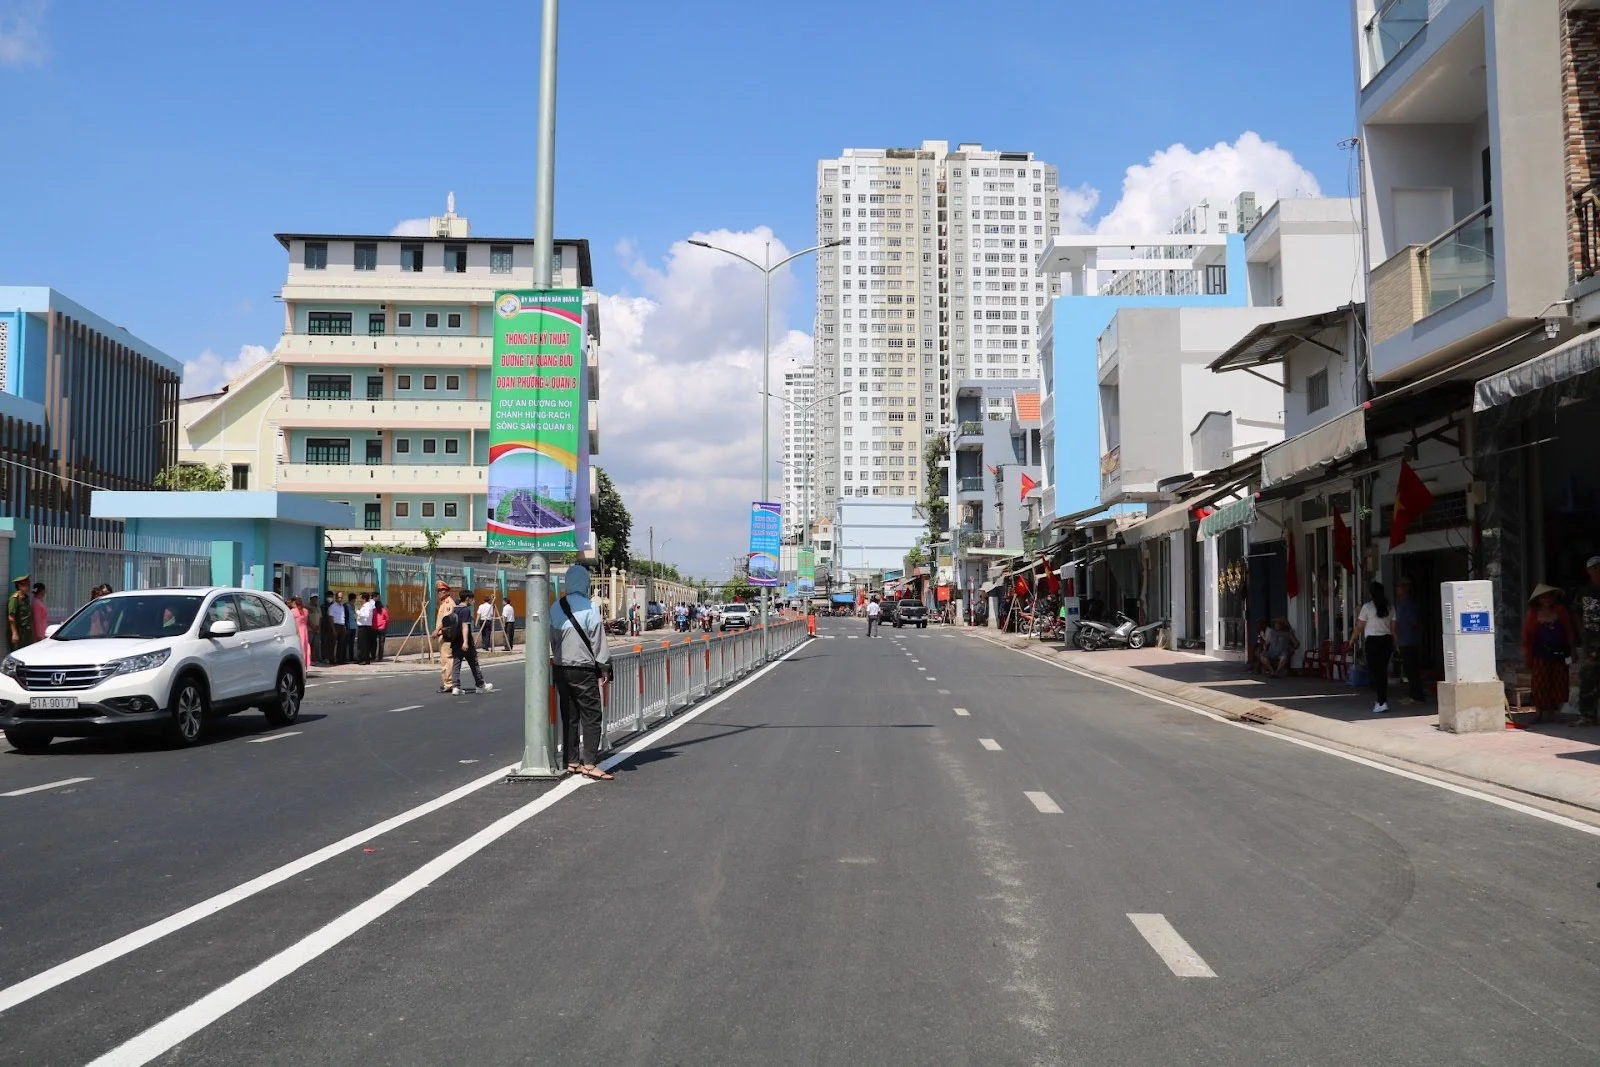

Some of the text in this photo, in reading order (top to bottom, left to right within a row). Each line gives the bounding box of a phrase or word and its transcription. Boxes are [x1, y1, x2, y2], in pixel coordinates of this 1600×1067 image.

[506, 331, 528, 345] THÔNG
[529, 333, 538, 345] XE
[536, 354, 558, 367] QUANG
